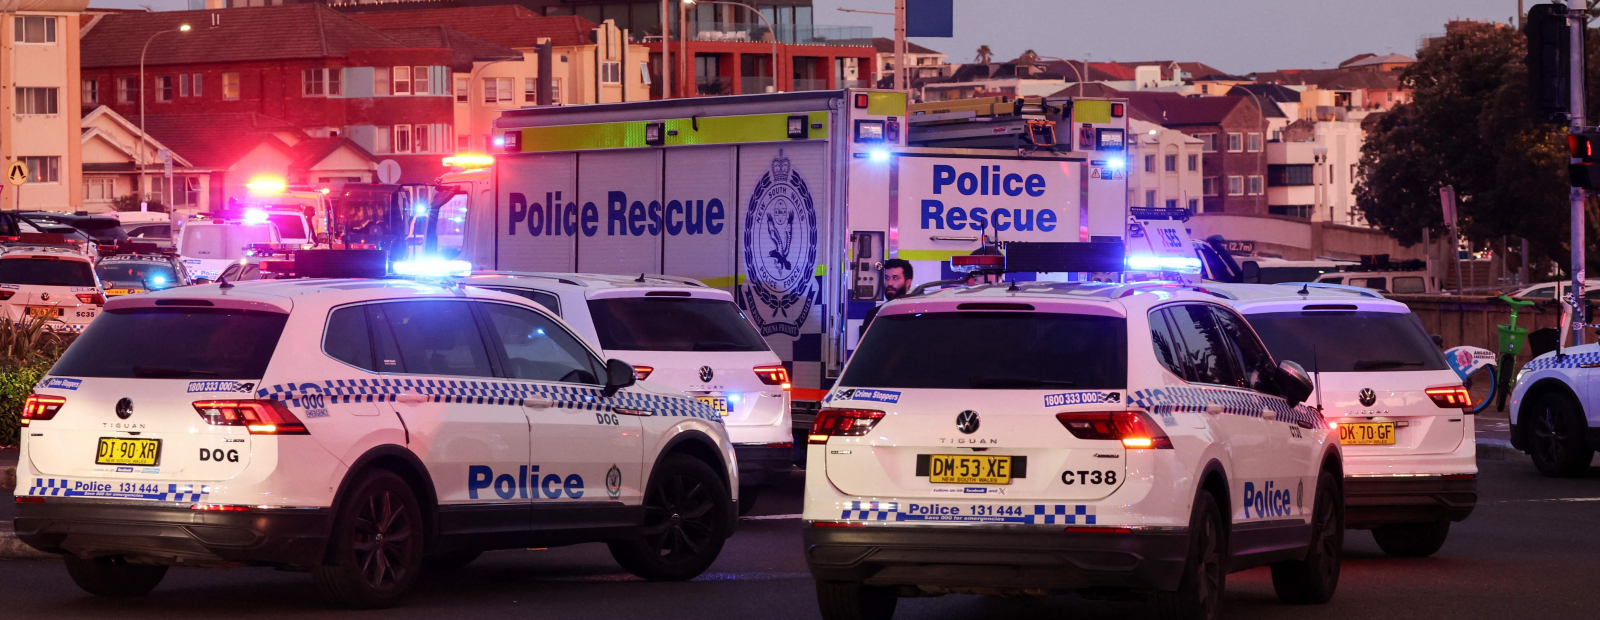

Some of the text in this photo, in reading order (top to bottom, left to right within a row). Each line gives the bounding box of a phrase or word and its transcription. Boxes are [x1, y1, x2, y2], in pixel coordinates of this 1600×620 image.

[933, 165, 1046, 197] Police
[508, 190, 725, 237] Police Rescue
[756, 188, 806, 224] NEW SOUTH WALES
[921, 199, 1057, 232] Rescue
[1229, 242, 1252, 251] (2.7m)
[759, 265, 801, 290] POLICE FORCE
[189, 382, 232, 392] 1800 333 000
[855, 390, 898, 402] Crime Stoppers
[1046, 392, 1098, 406] 1800 333 000
[596, 412, 620, 426] DOG
[200, 448, 239, 462] DOG
[468, 464, 584, 500] Police
[1061, 470, 1117, 486] CT38
[74, 481, 158, 493] Police 131 444
[1244, 480, 1291, 519] Police
[909, 504, 1022, 516] Police 131 444
